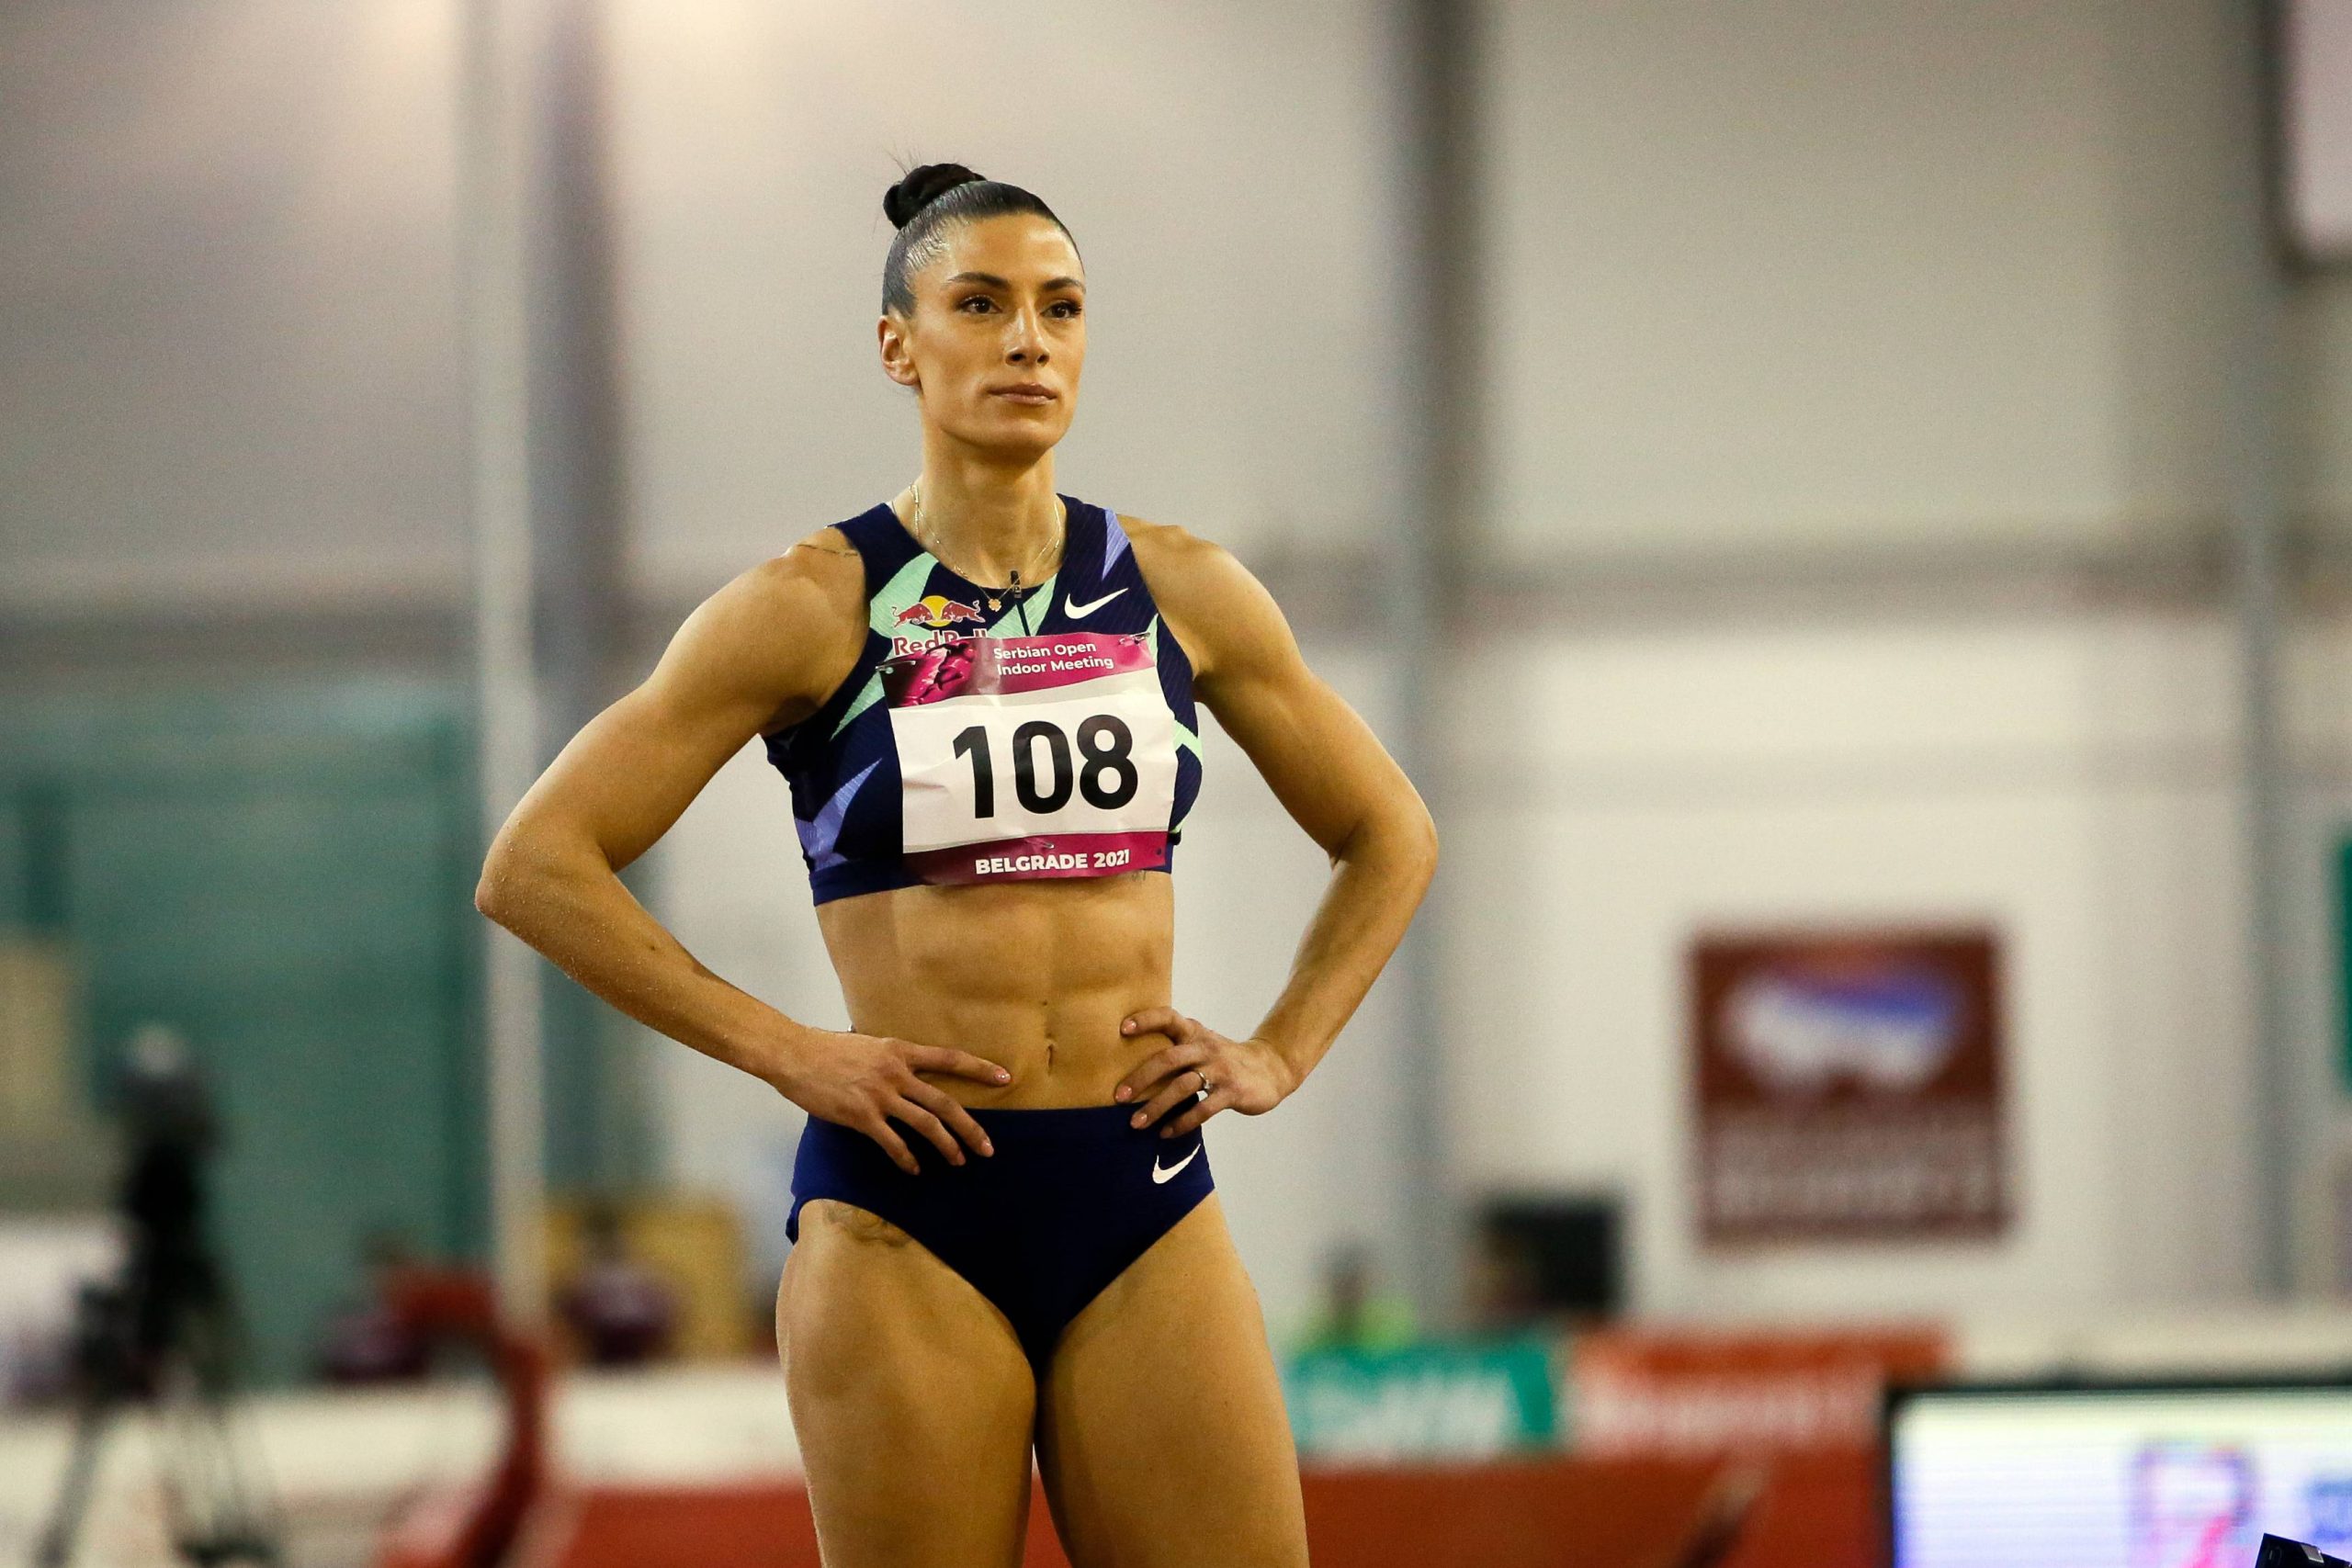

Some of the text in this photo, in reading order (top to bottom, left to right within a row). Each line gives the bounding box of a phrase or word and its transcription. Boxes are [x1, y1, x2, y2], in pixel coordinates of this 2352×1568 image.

[893, 630, 940, 656] Red
[993, 643, 1096, 660] Serbian Open
[997, 656, 1114, 676] Indoor Meeting
[953, 714, 1138, 818] 108
[976, 849, 1130, 874] BELGRADE 2021
